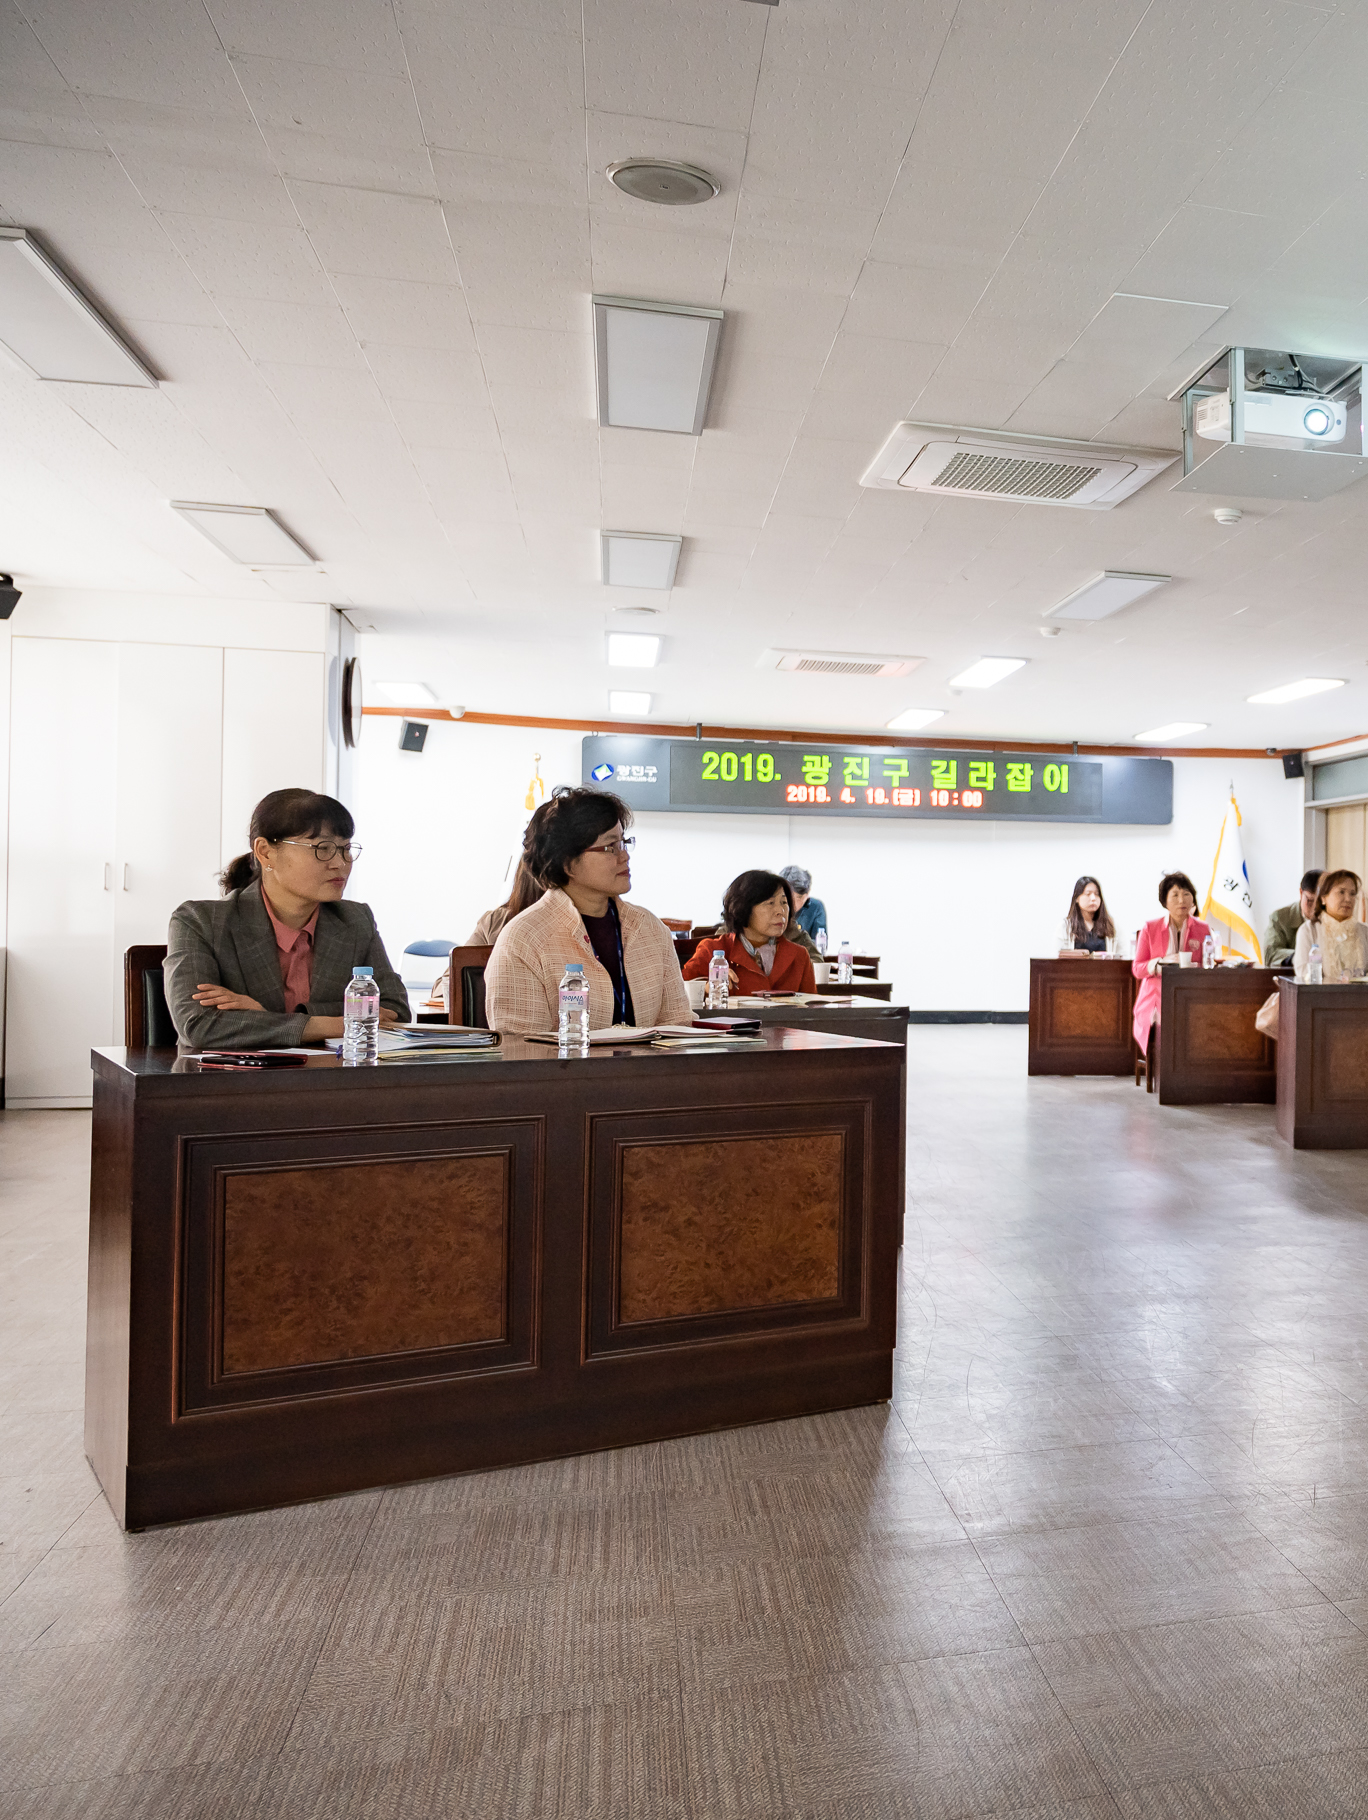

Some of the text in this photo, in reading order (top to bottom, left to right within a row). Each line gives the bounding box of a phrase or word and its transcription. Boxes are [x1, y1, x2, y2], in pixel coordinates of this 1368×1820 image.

[616, 764, 658, 777] 광진구
[701, 751, 782, 783] 2019.
[786, 784, 832, 803] 2019.
[839, 787, 856, 804] 4.
